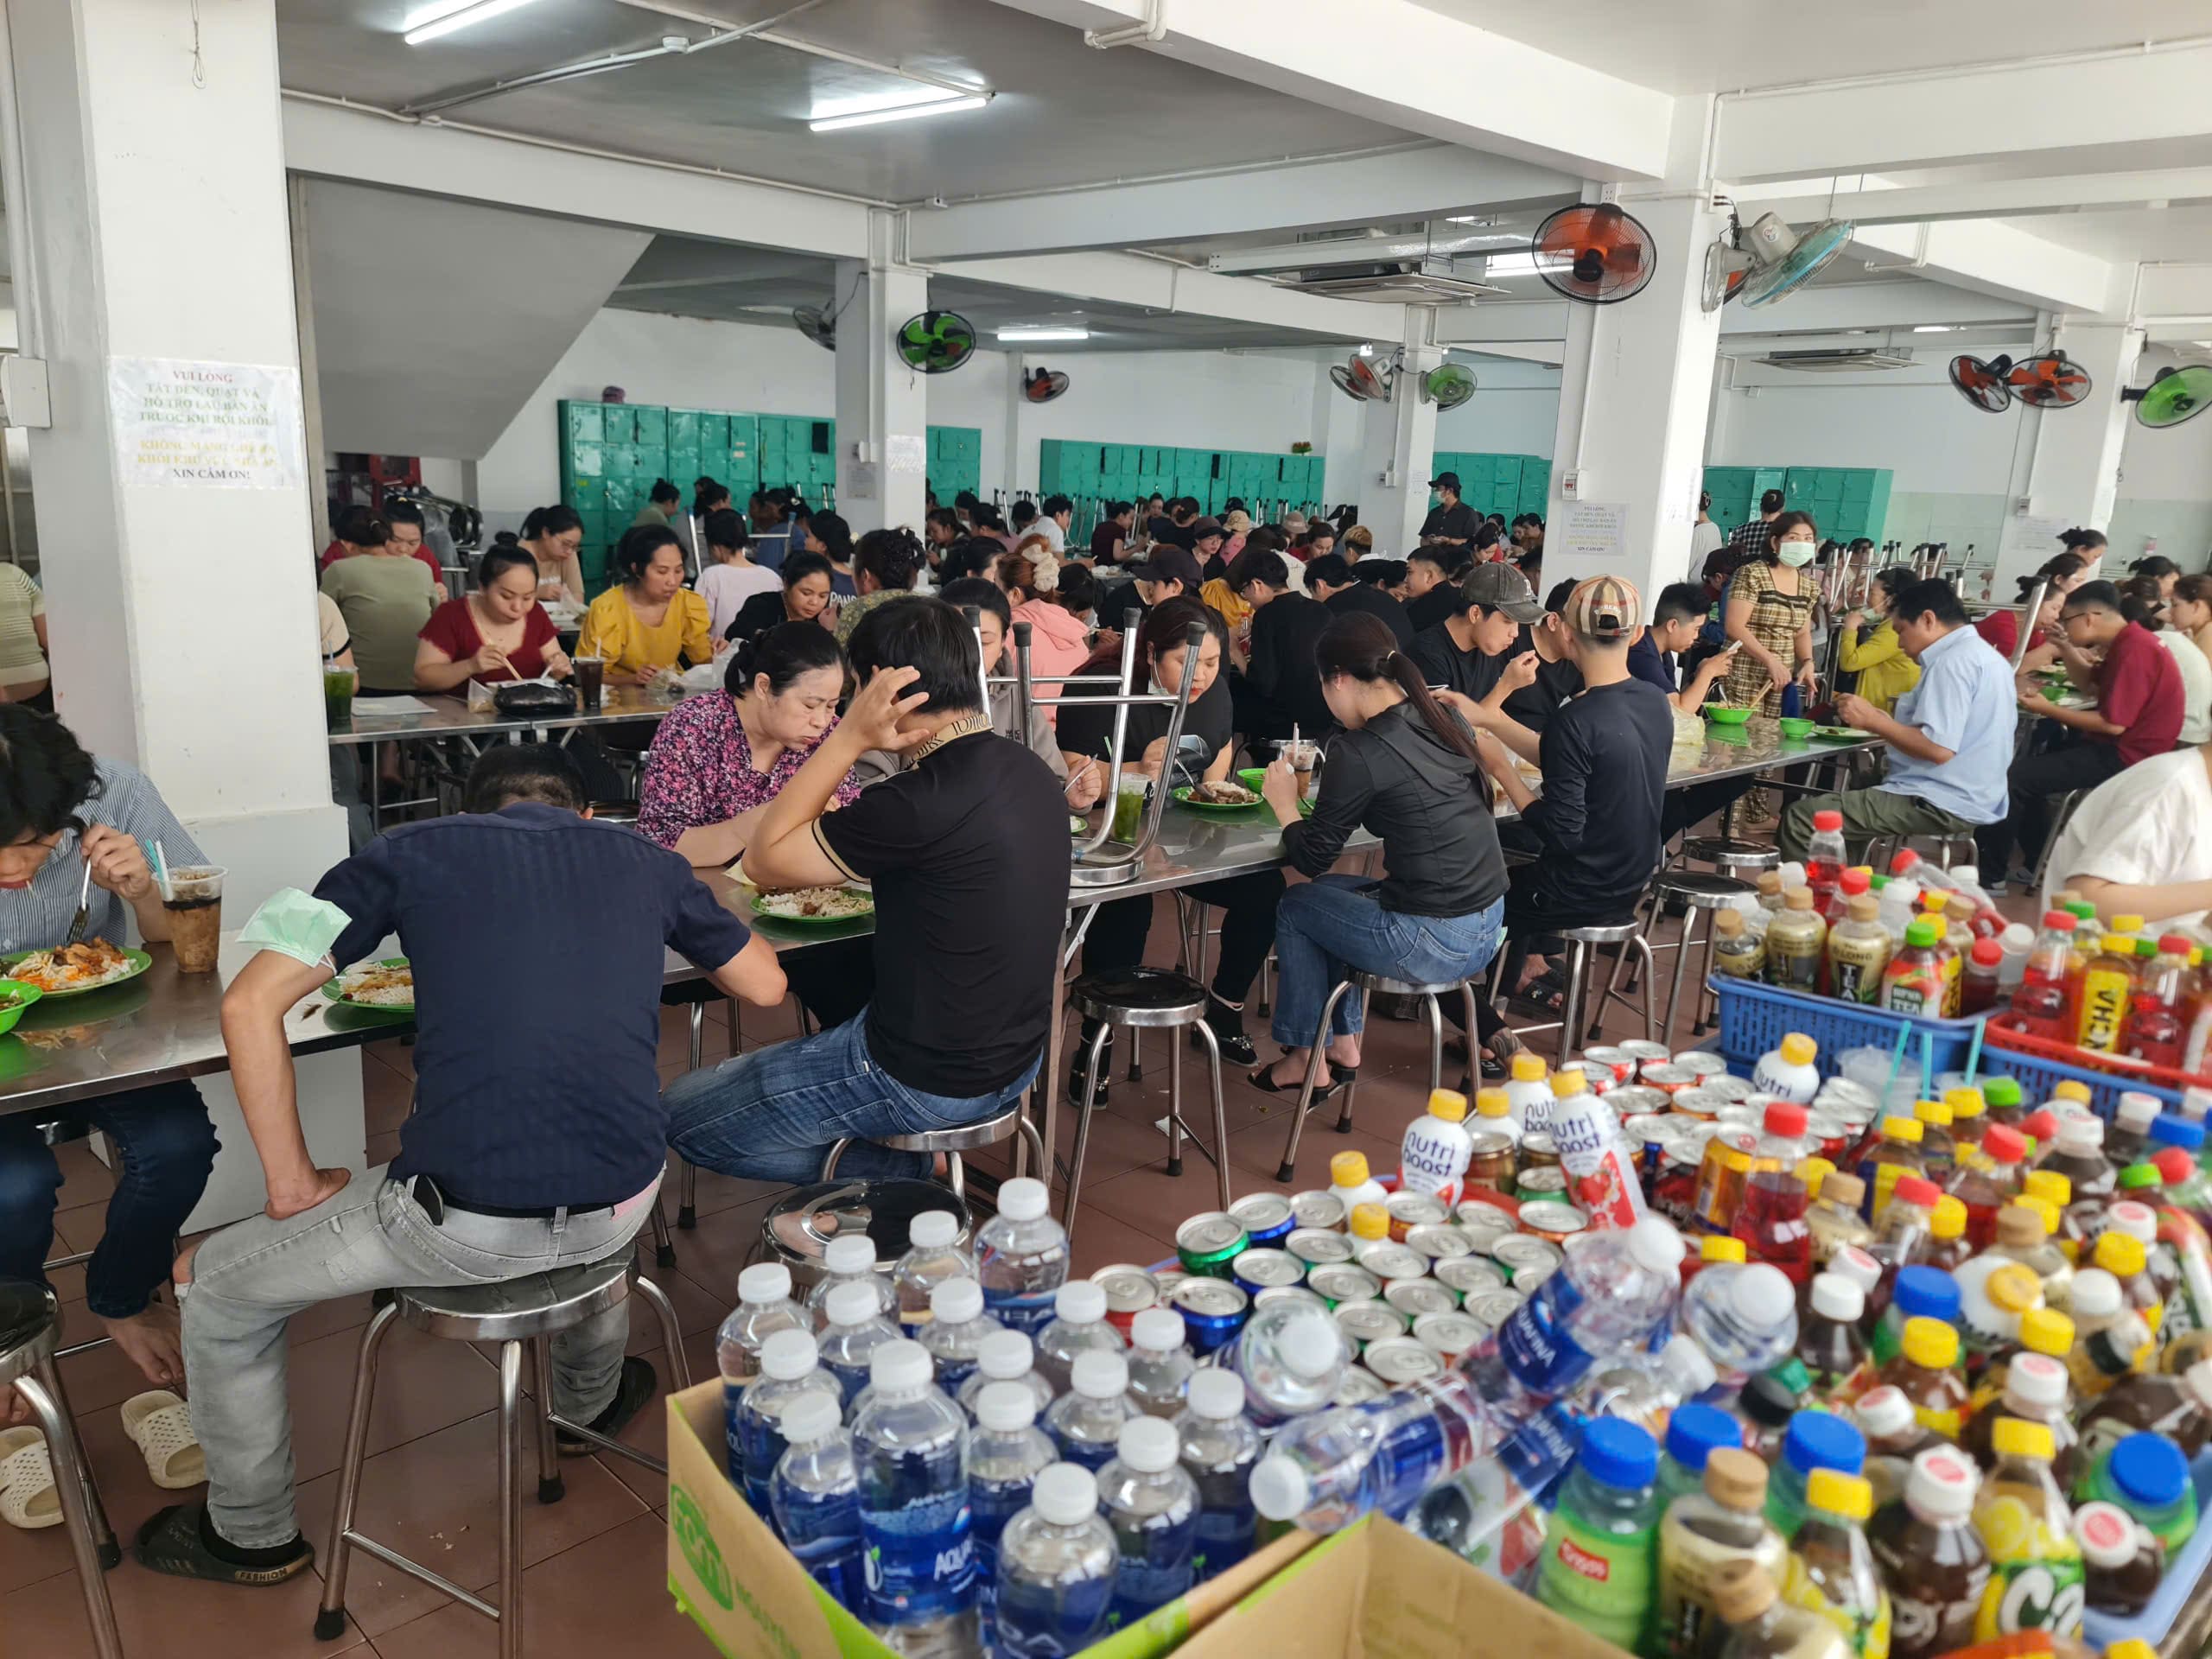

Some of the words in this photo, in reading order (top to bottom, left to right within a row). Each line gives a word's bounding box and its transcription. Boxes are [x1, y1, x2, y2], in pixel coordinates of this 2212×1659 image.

[173, 370, 194, 381] VUI
[173, 468, 194, 478] XIN
[1407, 1131, 1456, 1161] nutri
[1402, 1144, 1452, 1177] boost
[239, 1567, 288, 1581] FASHION
